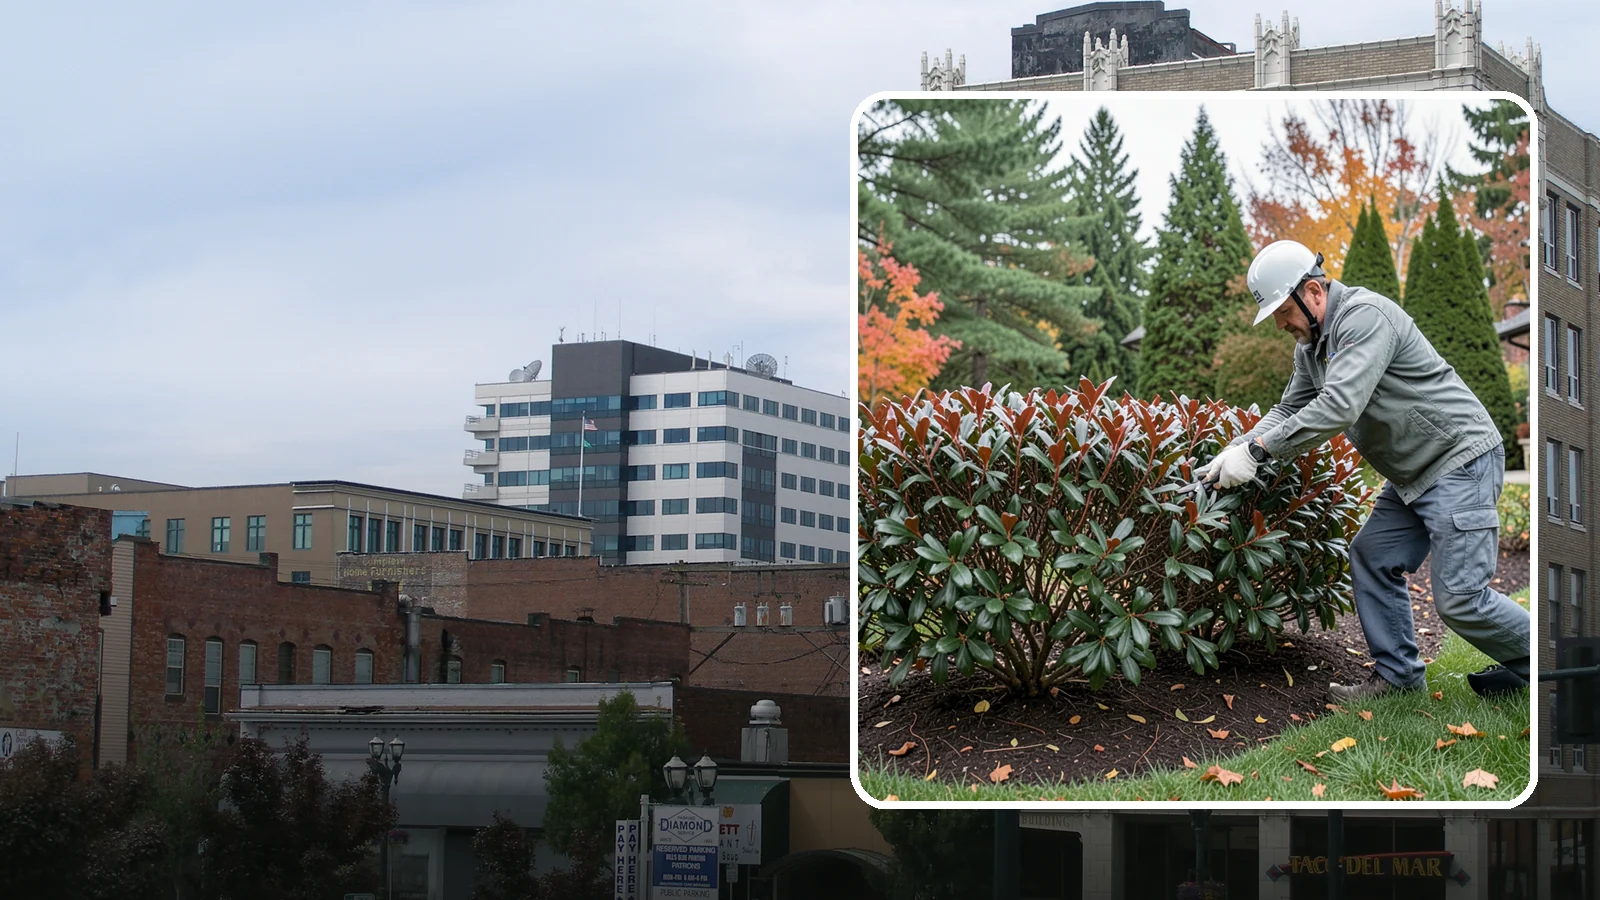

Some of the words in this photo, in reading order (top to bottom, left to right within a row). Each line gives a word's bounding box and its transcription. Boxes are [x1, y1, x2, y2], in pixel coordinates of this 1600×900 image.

[660, 818, 713, 832] DIAMOND
[1022, 815, 1070, 828] BUILDING
[617, 825, 625, 852] PAY
[628, 824, 636, 852] PAY
[656, 845, 688, 853] RESERVED
[616, 856, 625, 894] HERE
[627, 855, 636, 893] HERE
[671, 862, 701, 870] PATRONS
[1289, 855, 1329, 874] TAC
[1346, 857, 1384, 875] DEL
[1392, 858, 1442, 877] MAR
[660, 889, 682, 897] PUBLIC
